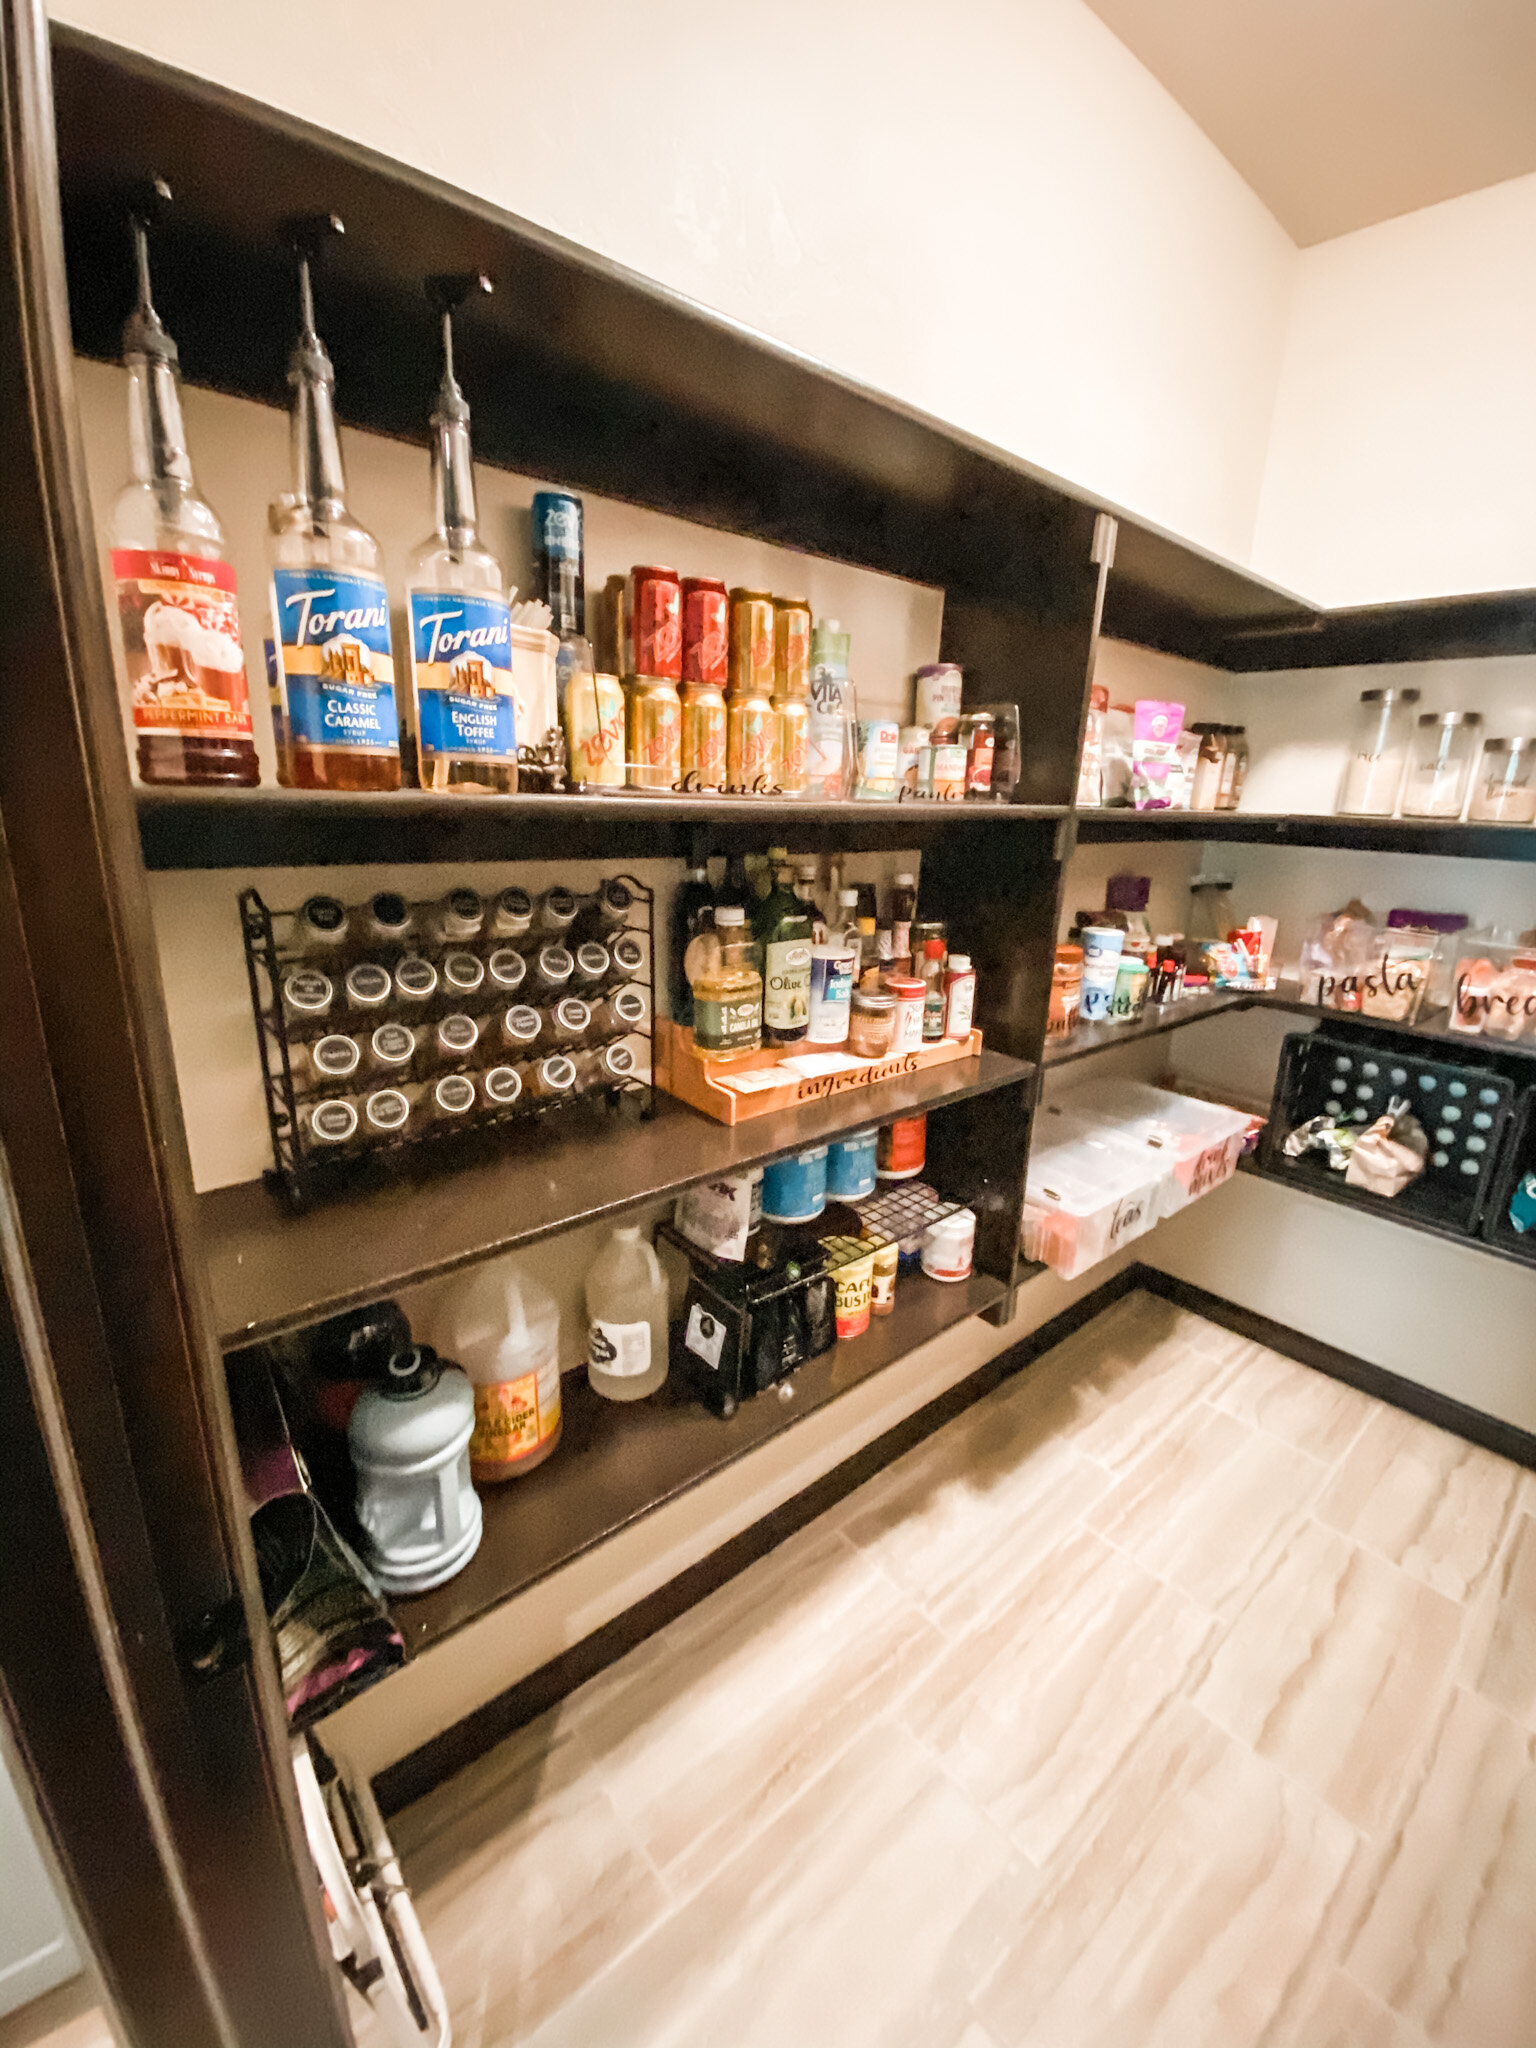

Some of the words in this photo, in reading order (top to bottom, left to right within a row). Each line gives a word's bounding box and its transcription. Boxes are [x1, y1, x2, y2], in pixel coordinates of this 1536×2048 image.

[286, 588, 386, 649] Torani
[420, 610, 508, 666] Torani
[322, 683, 355, 696] SUGAR
[357, 690, 378, 699] FREE
[327, 699, 377, 716] CLASSIC
[449, 696, 478, 708] SUGAR
[478, 702, 498, 712] FREE
[324, 713, 381, 730] CARAMEL
[451, 710, 498, 727] ENGLISH
[456, 723, 495, 739] TOFFEE
[671, 770, 783, 795] drinks
[770, 976, 802, 991] Olive
[1318, 953, 1420, 1005] pasta
[798, 1053, 920, 1098] ingredients
